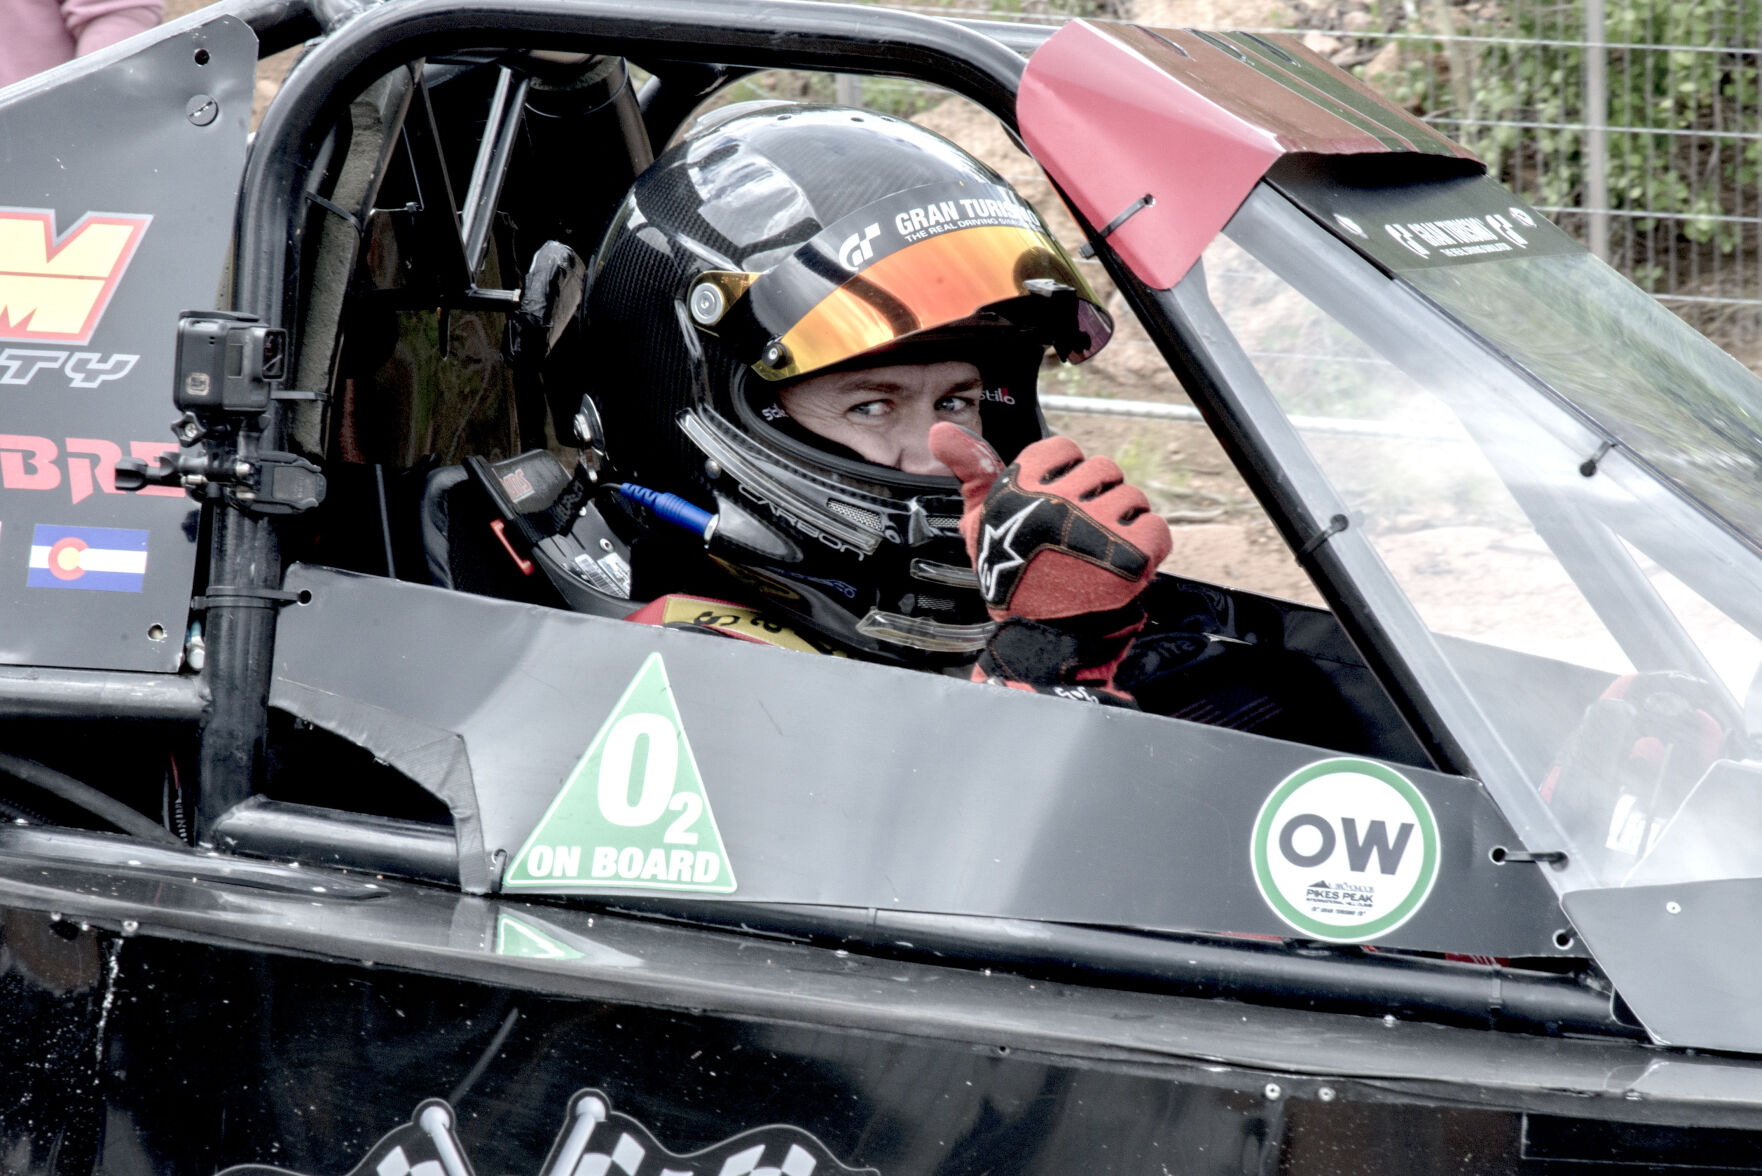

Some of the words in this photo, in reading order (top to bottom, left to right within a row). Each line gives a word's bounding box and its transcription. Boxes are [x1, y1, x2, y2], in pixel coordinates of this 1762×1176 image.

[895, 202, 959, 235] GRAN
[904, 229, 929, 243] THE
[928, 222, 958, 236] REAL
[957, 217, 1000, 229] DRIVING
[1279, 813, 1415, 875] OW
[527, 844, 582, 878] ON
[591, 846, 720, 883] BOARD
[1306, 888, 1340, 900] PIKES
[1342, 892, 1373, 903] PEAK
